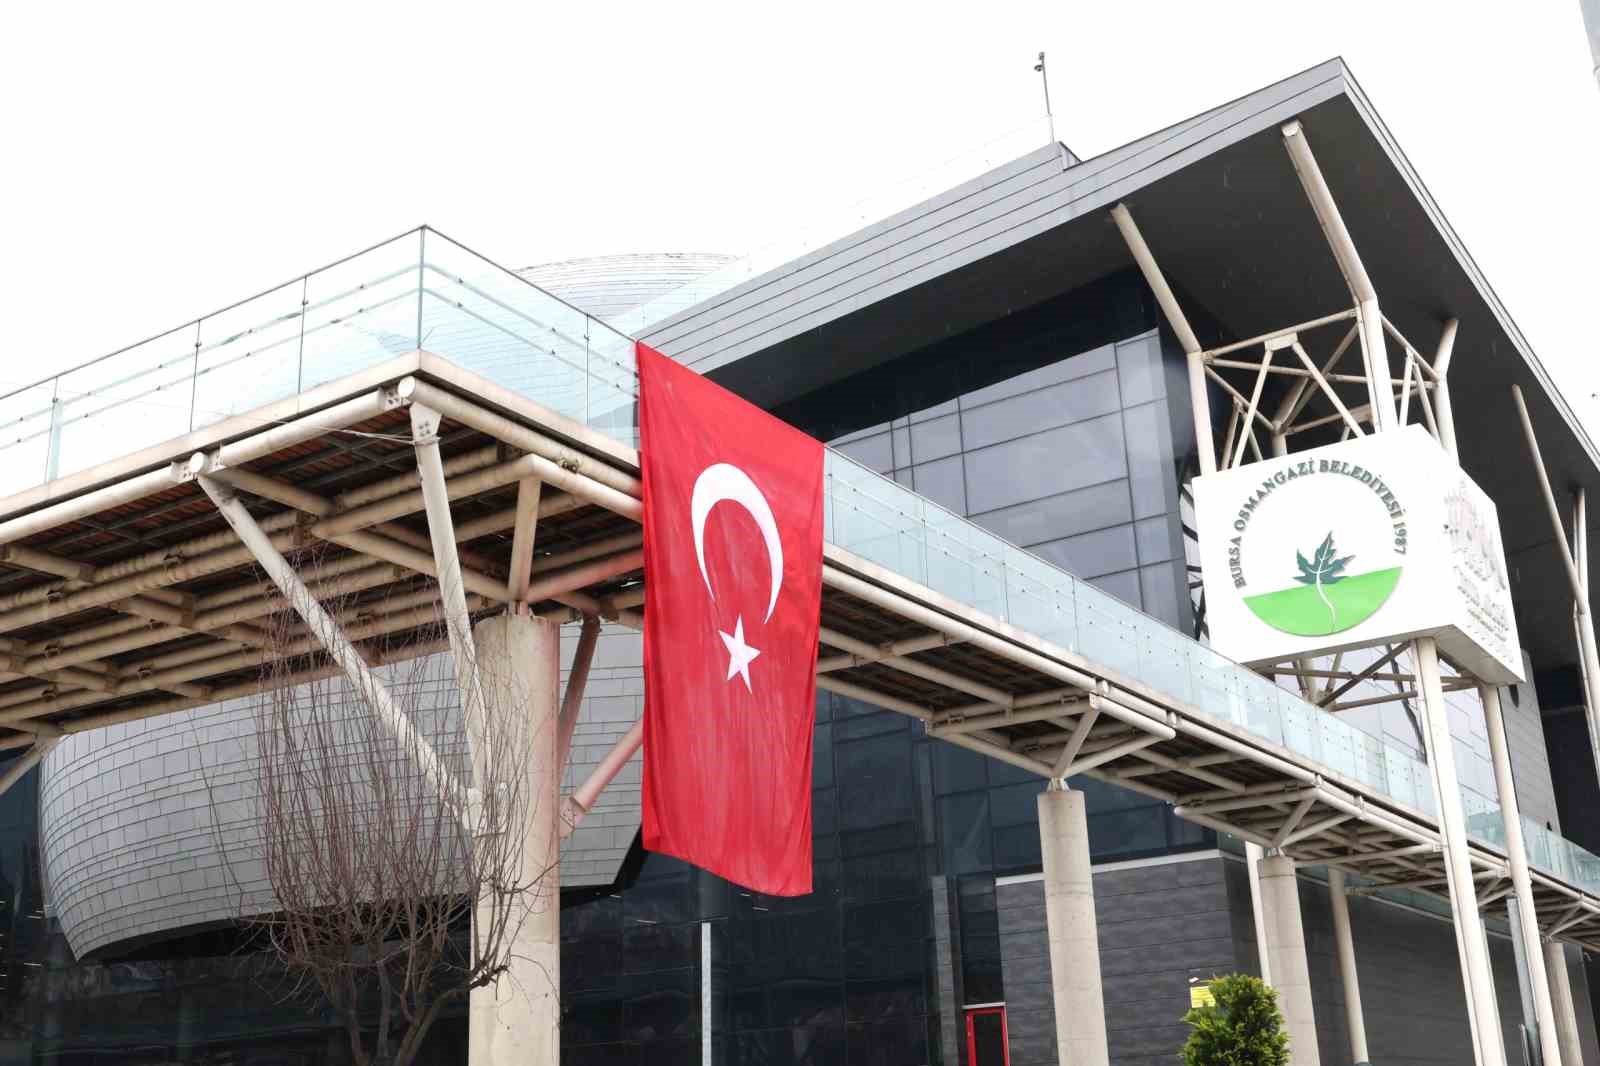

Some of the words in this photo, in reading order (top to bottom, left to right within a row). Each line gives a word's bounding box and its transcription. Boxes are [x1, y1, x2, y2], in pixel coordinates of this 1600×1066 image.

[1234, 457, 1315, 531] OSMANGAZİ
[1320, 459, 1406, 519] BELEDİYESİ
[1229, 536, 1247, 589] BURSA
[1393, 522, 1408, 555] 1987
